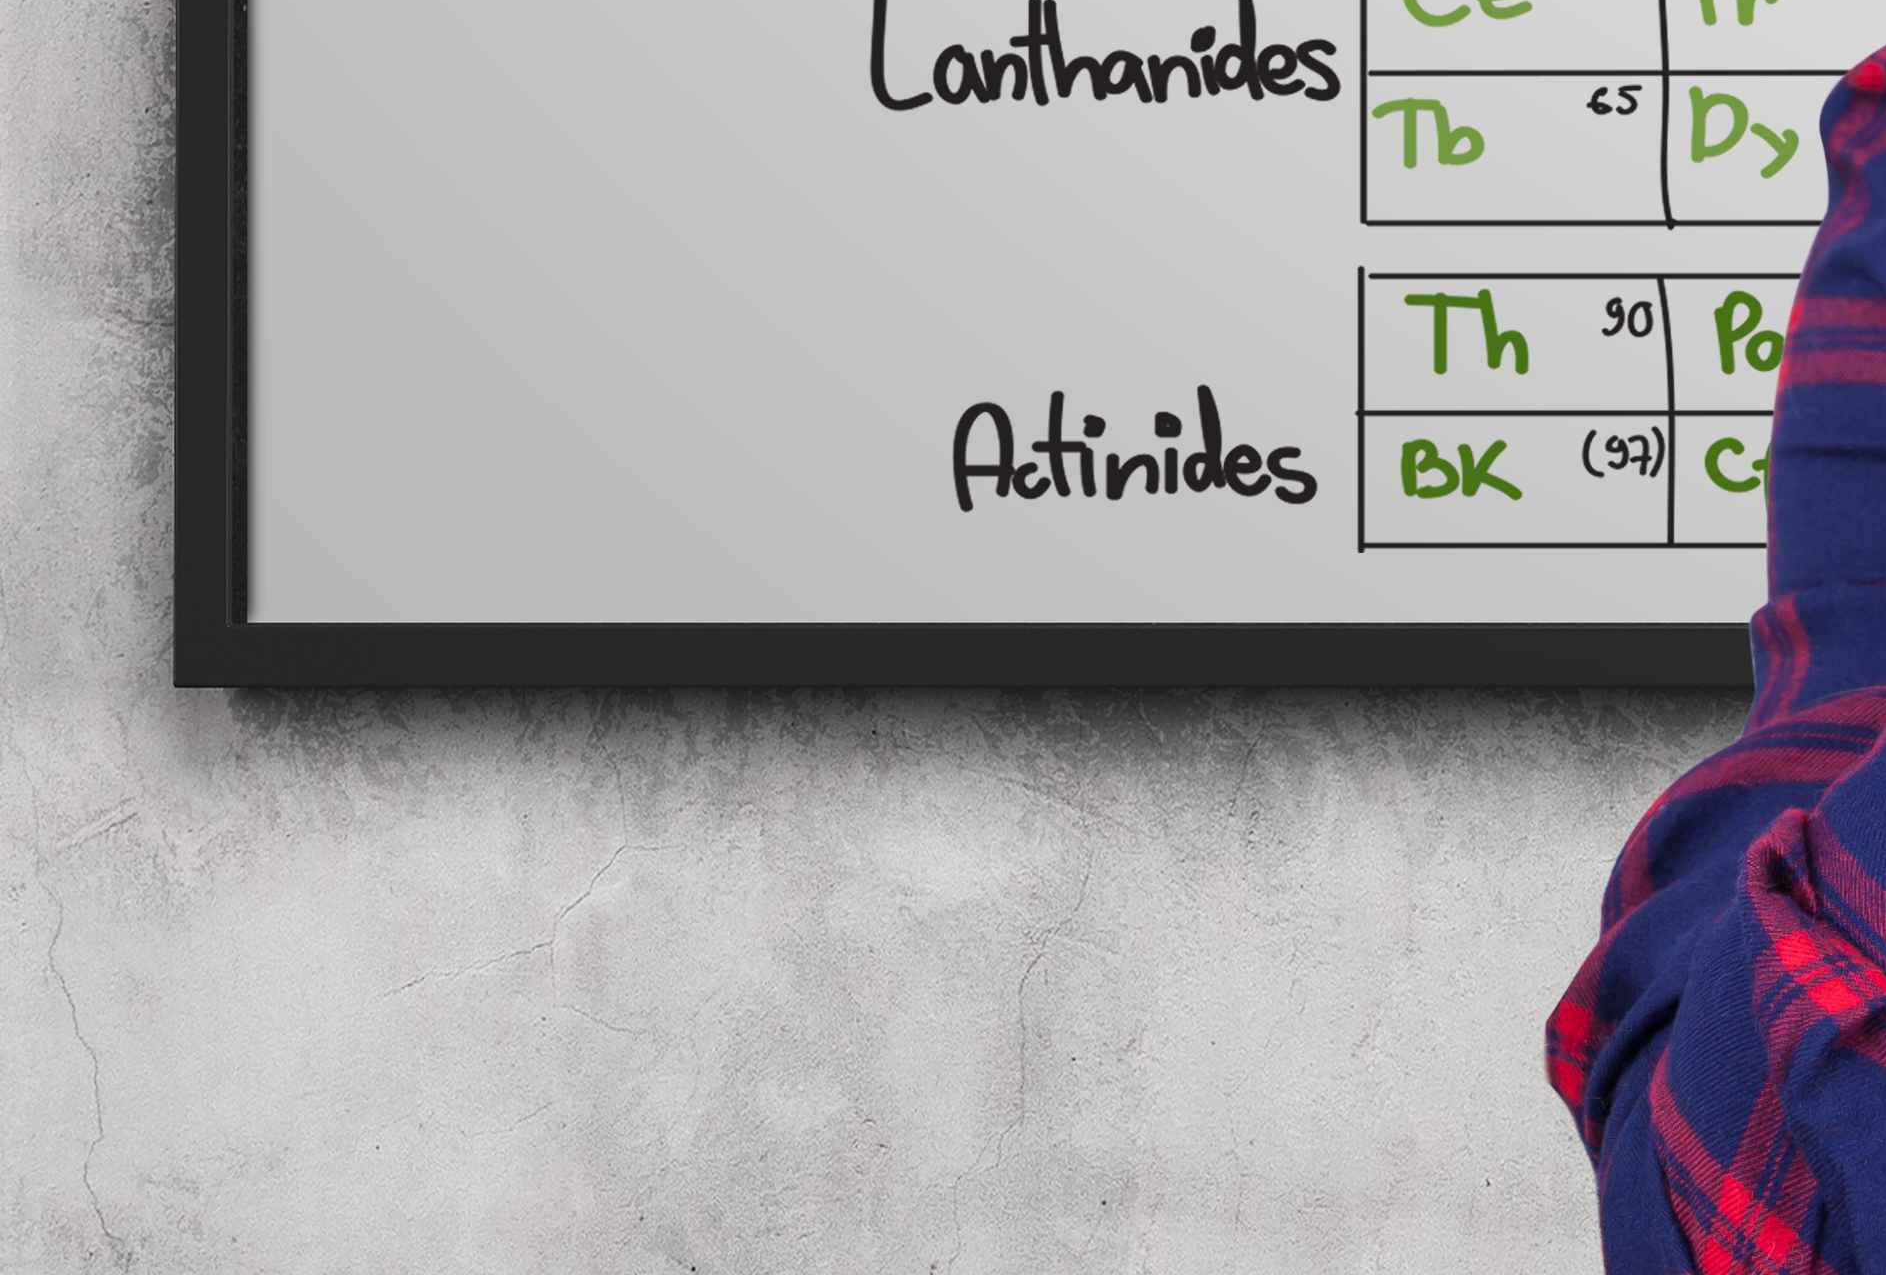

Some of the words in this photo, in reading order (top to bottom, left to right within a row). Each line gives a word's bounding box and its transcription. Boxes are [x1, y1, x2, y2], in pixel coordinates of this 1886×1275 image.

[1372, 98, 1484, 168] Tb
[1588, 86, 1643, 116] 65
[1689, 86, 1799, 178] Dy
[1404, 289, 1529, 375] Th
[1601, 297, 1654, 338] 90
[952, 384, 1318, 513] Actinides
